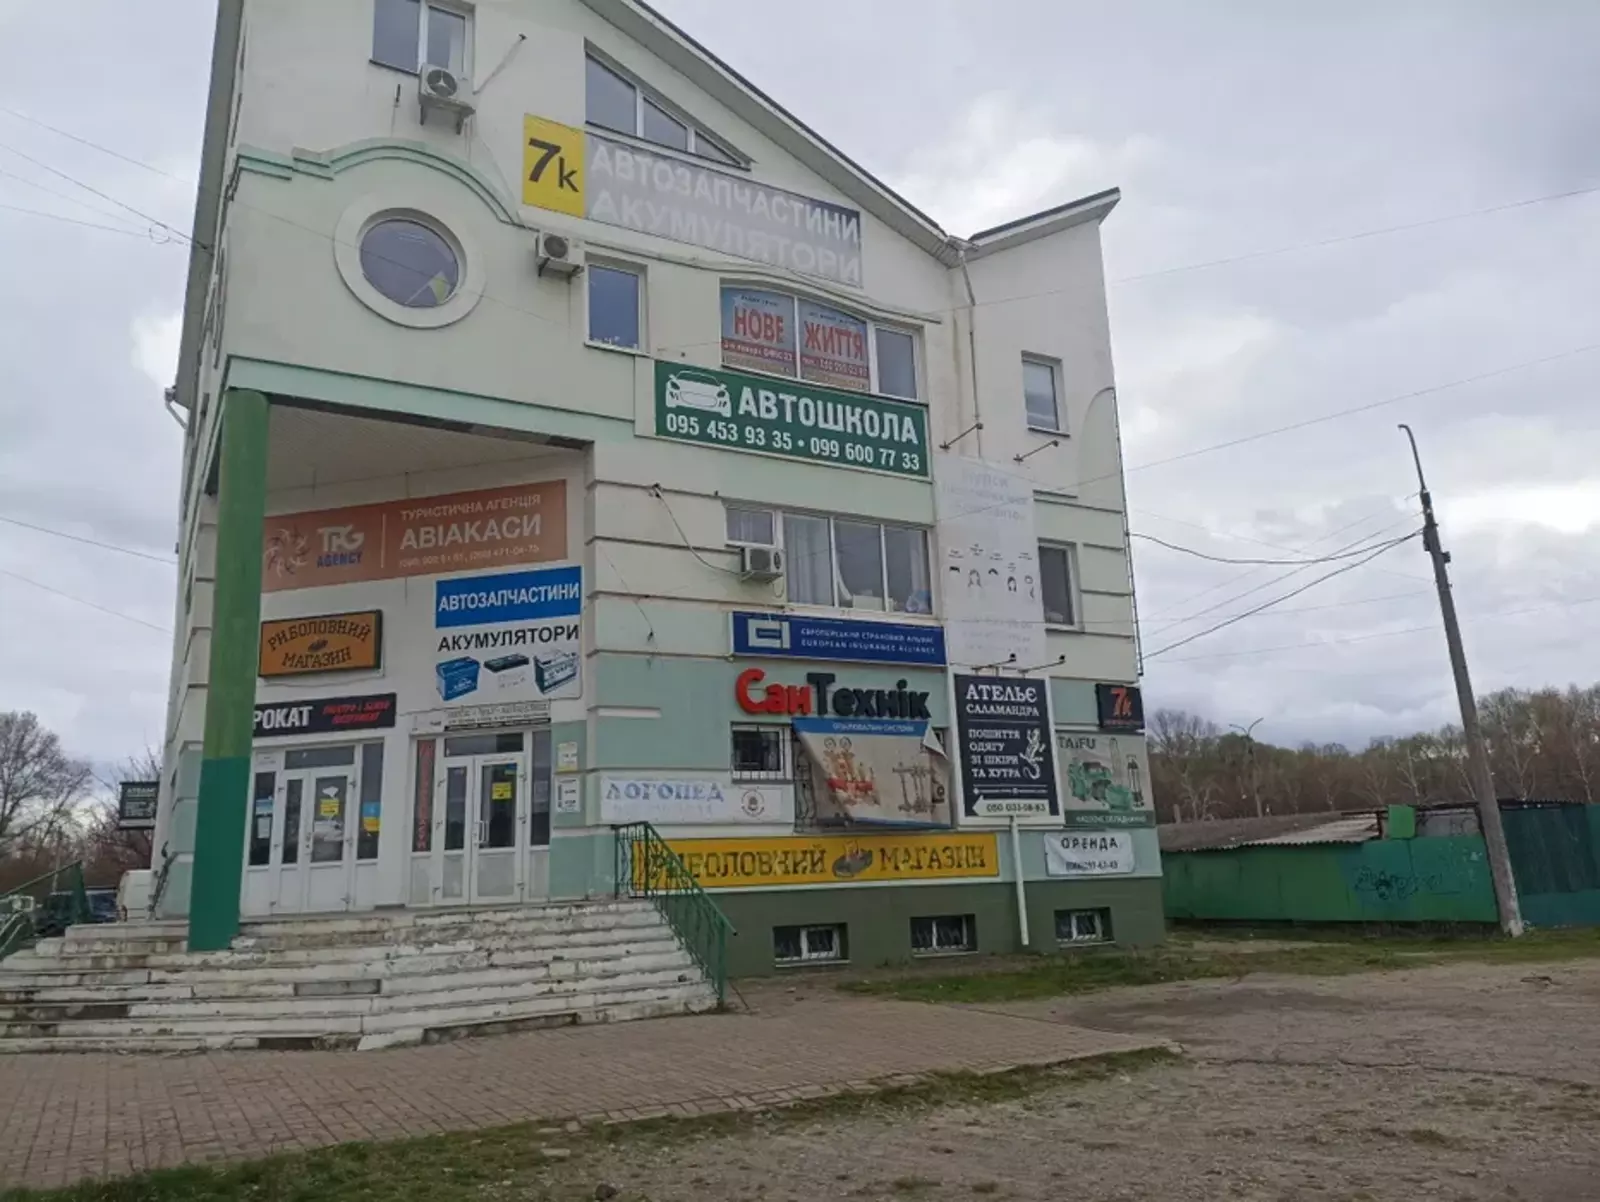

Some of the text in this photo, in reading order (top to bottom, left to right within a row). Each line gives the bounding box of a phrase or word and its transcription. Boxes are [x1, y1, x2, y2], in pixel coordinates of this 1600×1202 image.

[590, 145, 860, 243] АВТОЗАПЧАСТИНИ
[590, 188, 861, 284] АКУМУЛЯТОРИ
[734, 306, 864, 361] НОВЕ ЖИТТЯ
[738, 386, 919, 445] АВТОШКОЛА
[666, 413, 920, 470] 095 453 93 35 099 600 77 33
[401, 494, 541, 521] ТУРИСТИЧНА АГЕНЦІЯ
[400, 513, 541, 550] АВІАКАСИ
[438, 582, 580, 612] АВТОЗАПЧАСТИНИ
[267, 619, 371, 652] РИБОЛОВНИЙ
[437, 624, 579, 652] АКУМУЛЯТОРИ
[281, 646, 352, 669] МАГАЗИН
[735, 668, 931, 719] СанТехнік
[965, 684, 1038, 703] АТЕЛЬЄ
[966, 703, 1040, 717] САЛАМАНДРА
[969, 742, 1005, 753] ОДЯГУ
[971, 768, 1022, 779] ТА ХУТРА
[606, 781, 725, 803] ЛОГОПЕД
[1061, 836, 1119, 852] ОРЕНДА
[879, 846, 986, 872] МАГАЗИН
